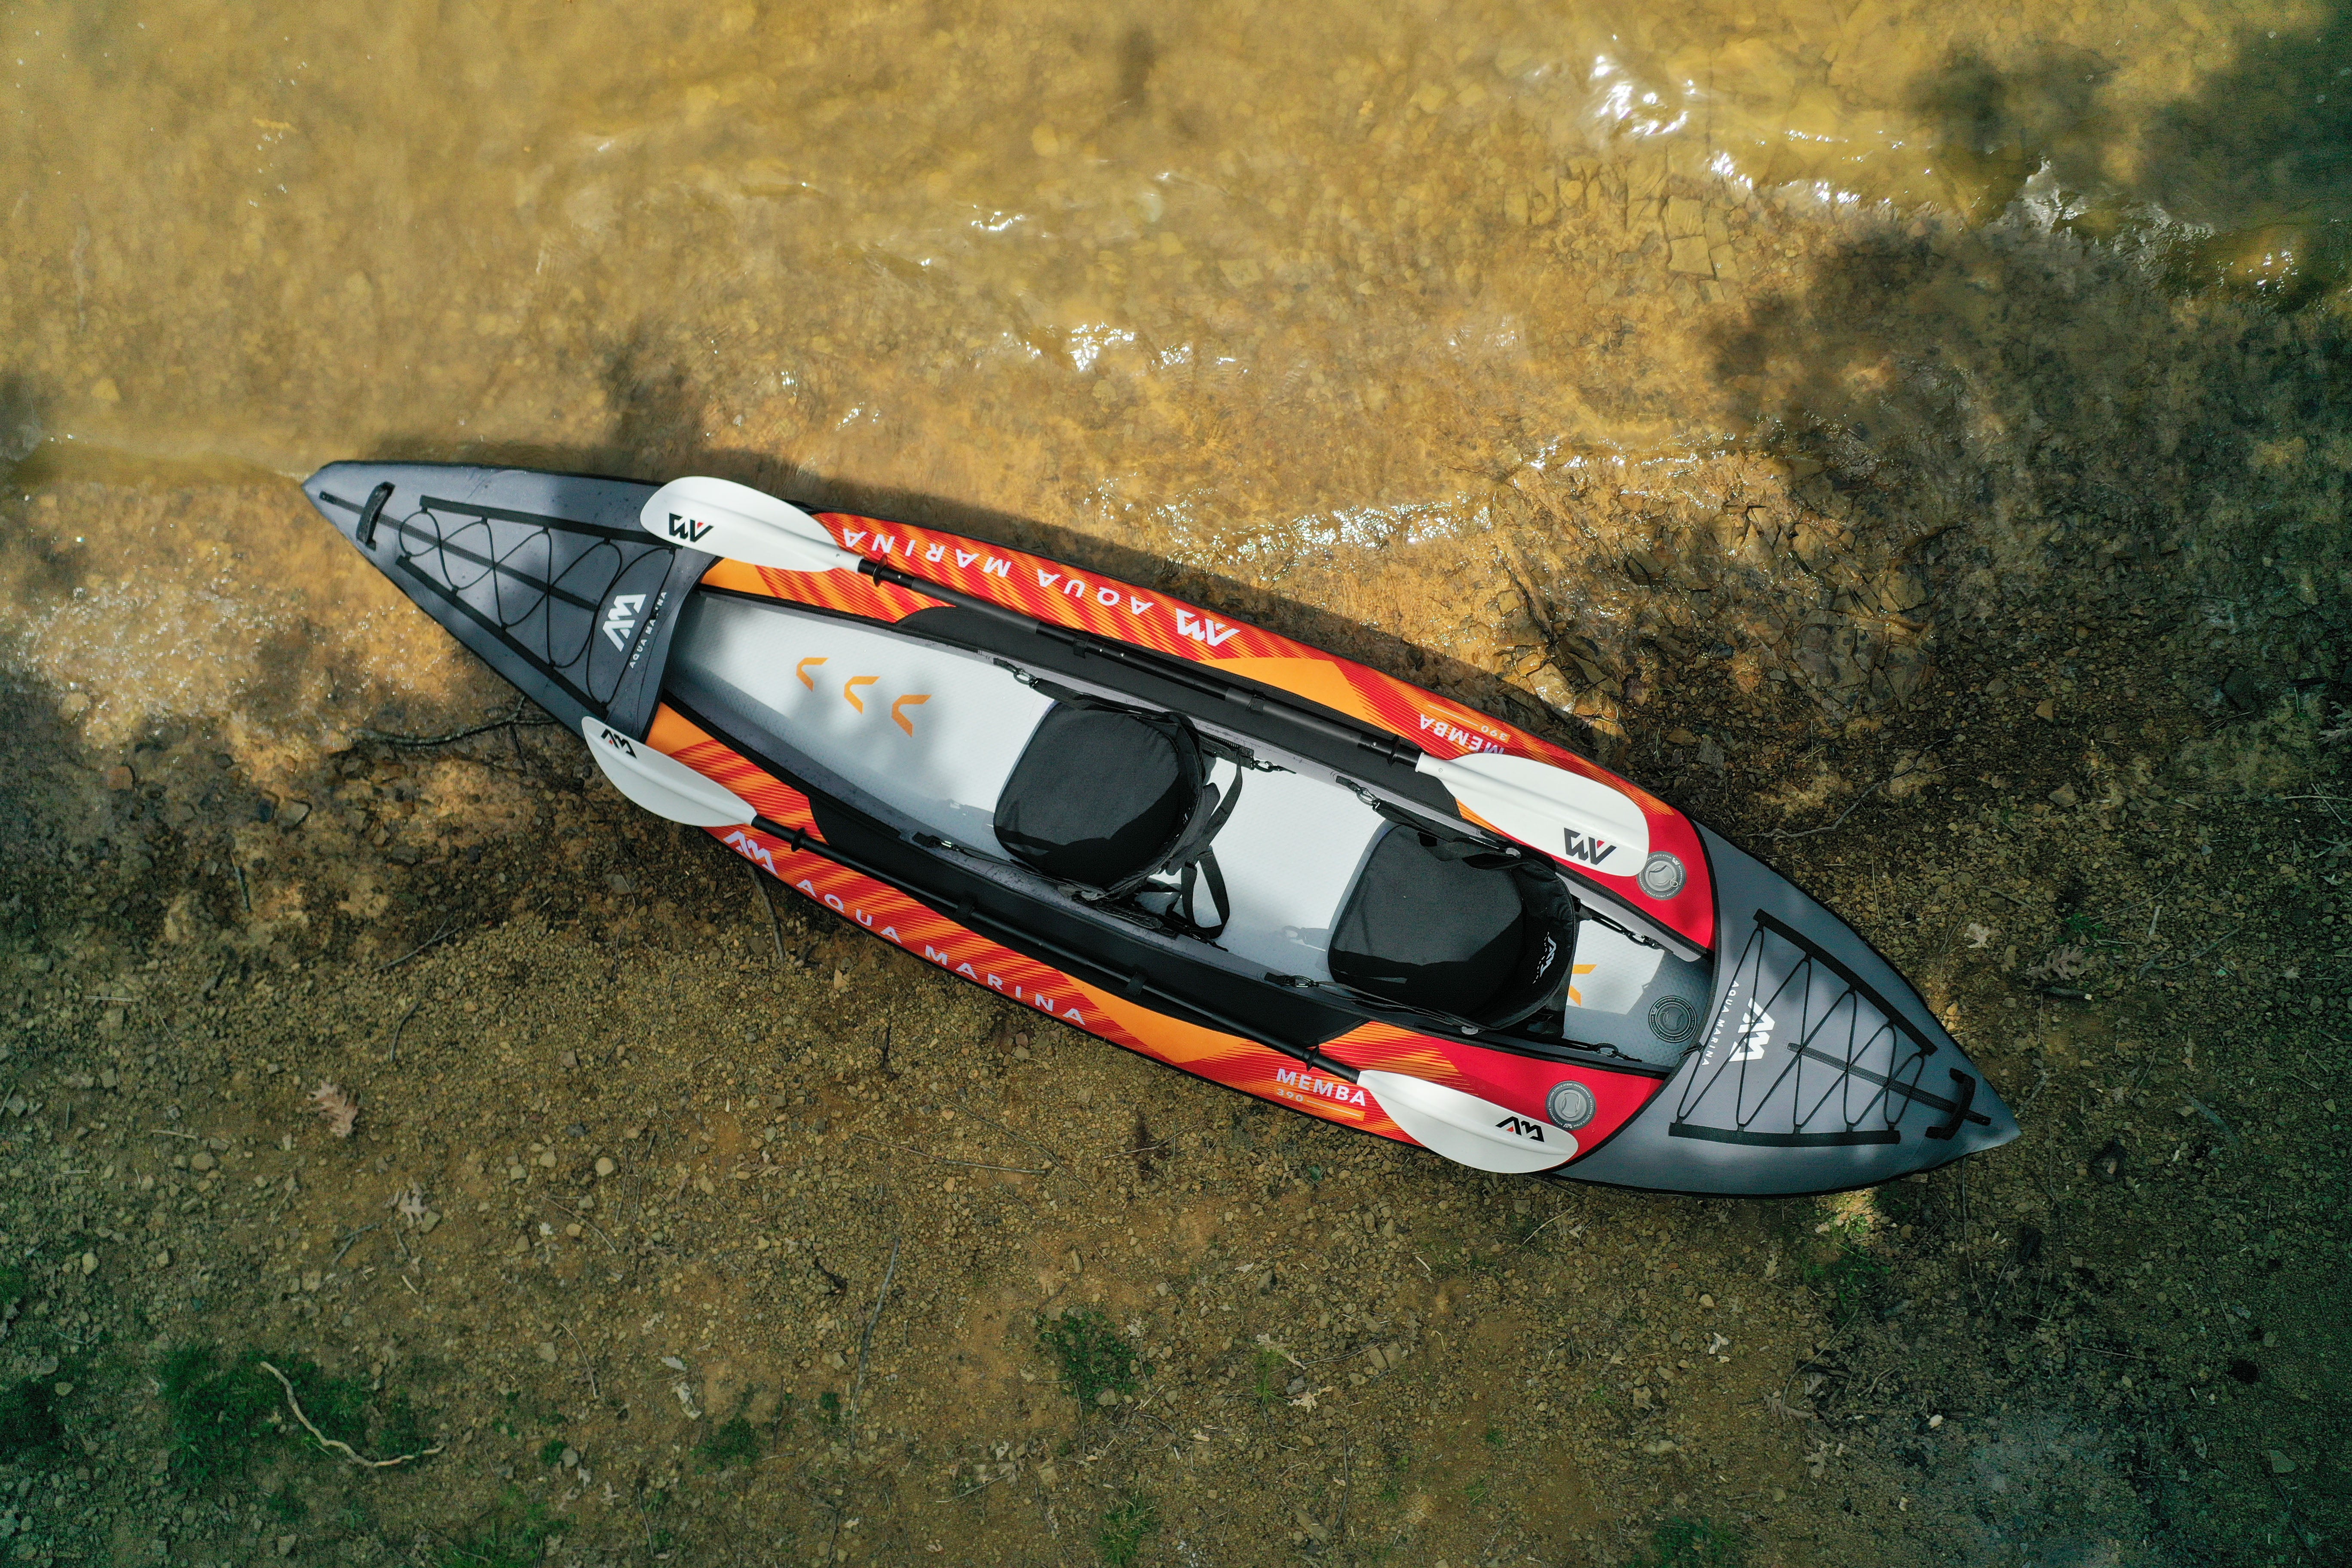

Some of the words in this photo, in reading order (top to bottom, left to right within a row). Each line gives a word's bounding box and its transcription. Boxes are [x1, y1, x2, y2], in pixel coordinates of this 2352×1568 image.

[842, 528, 1012, 578] MARINA
[1037, 568, 1155, 616] AQUA
[629, 639, 647, 669] AQUA
[646, 592, 667, 634] MAINA
[1420, 713, 1504, 754] MEMBA
[1481, 725, 1508, 741] 390
[796, 879, 902, 944] AQUA
[925, 945, 1086, 1026] MARINA
[1722, 980, 1740, 1013] AQUA
[1702, 1019, 1725, 1066] MARINA
[1276, 1068, 1366, 1107] MEMBA
[1277, 1088, 1304, 1102] 390
